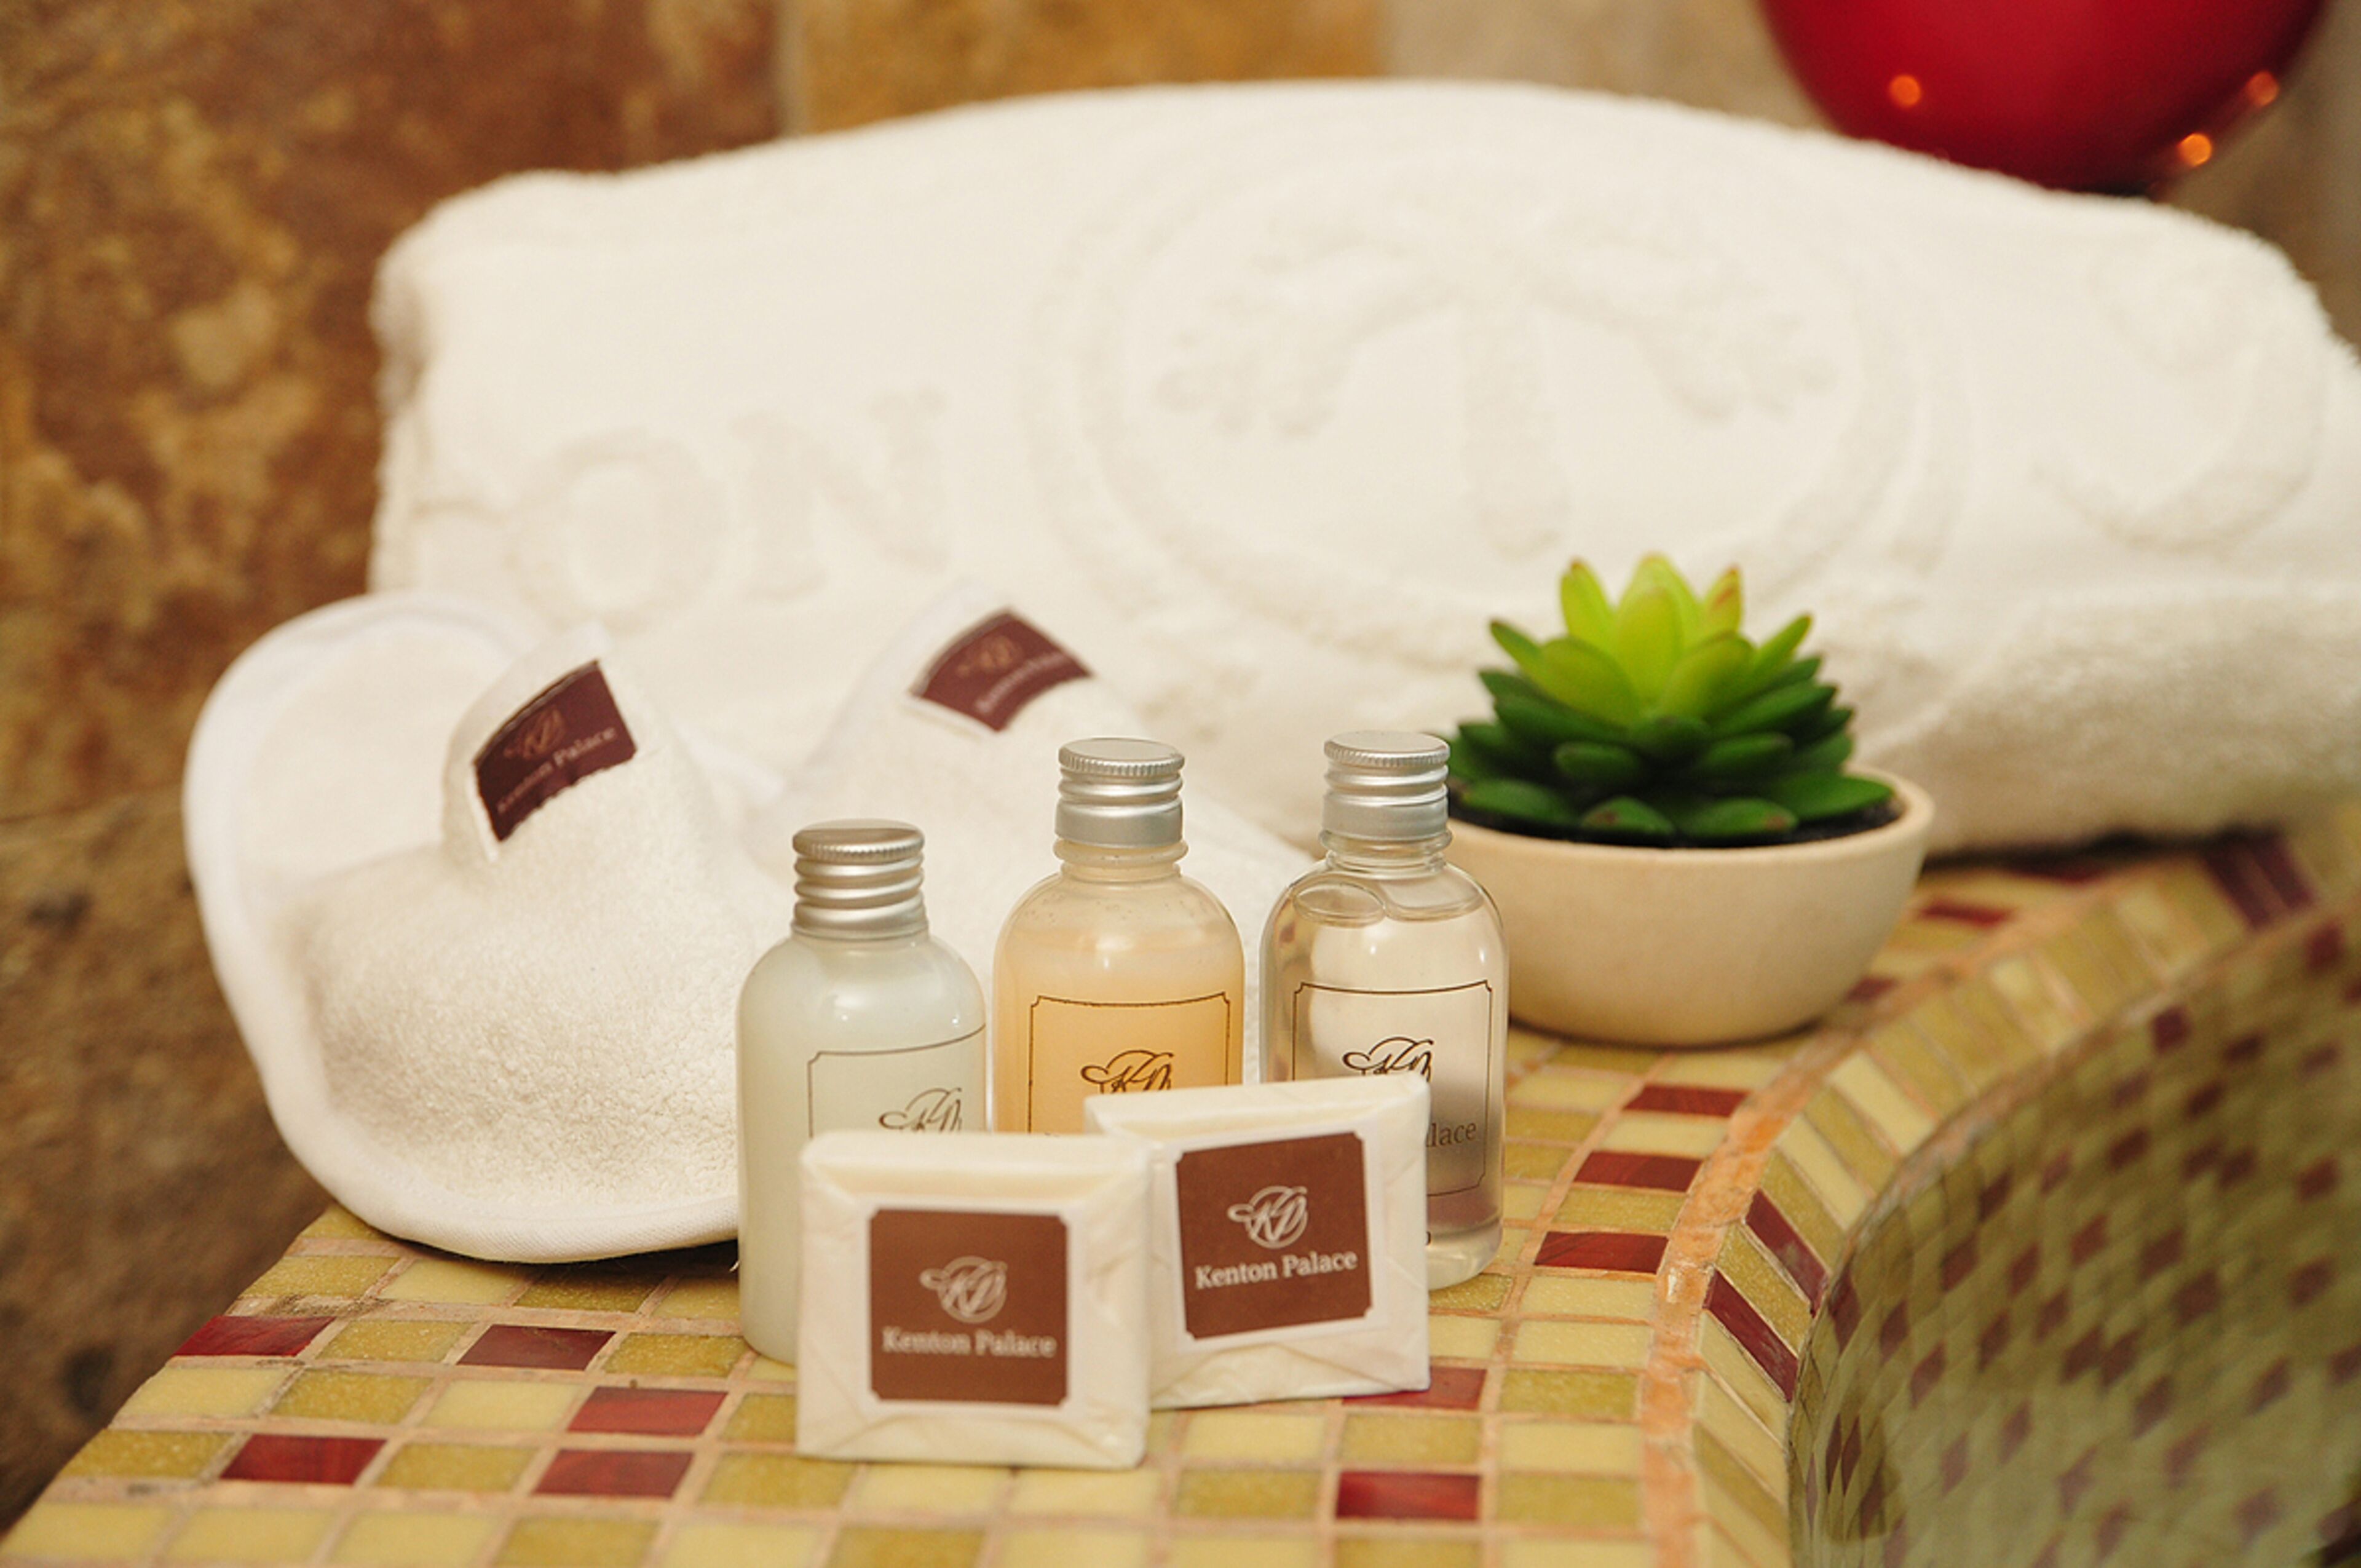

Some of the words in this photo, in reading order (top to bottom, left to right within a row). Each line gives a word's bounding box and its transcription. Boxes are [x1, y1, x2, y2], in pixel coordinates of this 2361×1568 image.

[1426, 1122, 1476, 1148] lace
[1194, 1261, 1278, 1289] Kenton
[1281, 1251, 1358, 1278] Palace
[882, 1326, 971, 1355] Kenton
[975, 1329, 1058, 1358] Palace
